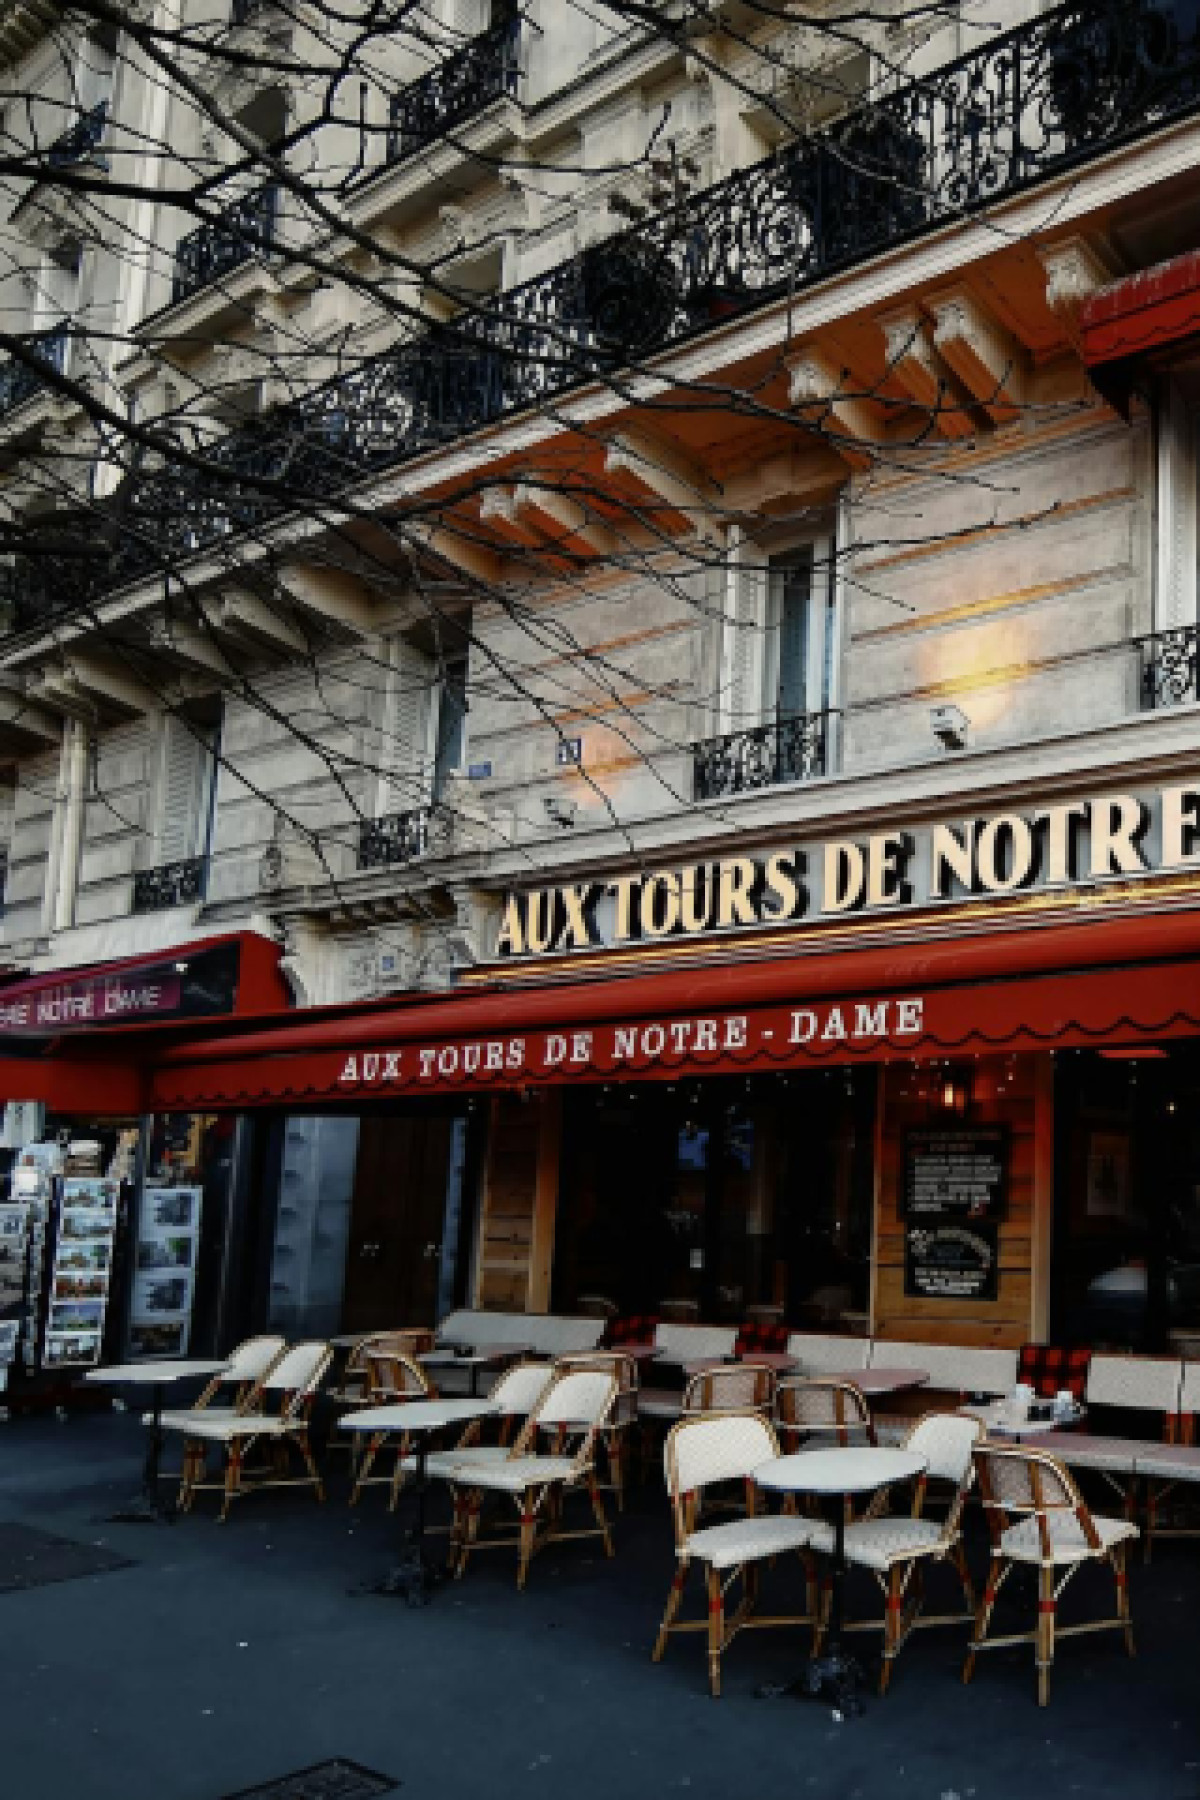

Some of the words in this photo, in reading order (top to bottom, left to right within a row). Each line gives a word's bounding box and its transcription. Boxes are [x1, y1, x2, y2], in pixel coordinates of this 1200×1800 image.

[497, 882, 594, 954] AUX
[602, 850, 803, 941] TOURS
[821, 835, 910, 913] DE
[339, 1051, 402, 1082] AUX
[418, 1038, 526, 1078] TOURS
[543, 1031, 594, 1067] DE
[610, 1015, 750, 1060] NOTRE
[787, 997, 925, 1044] DAME
